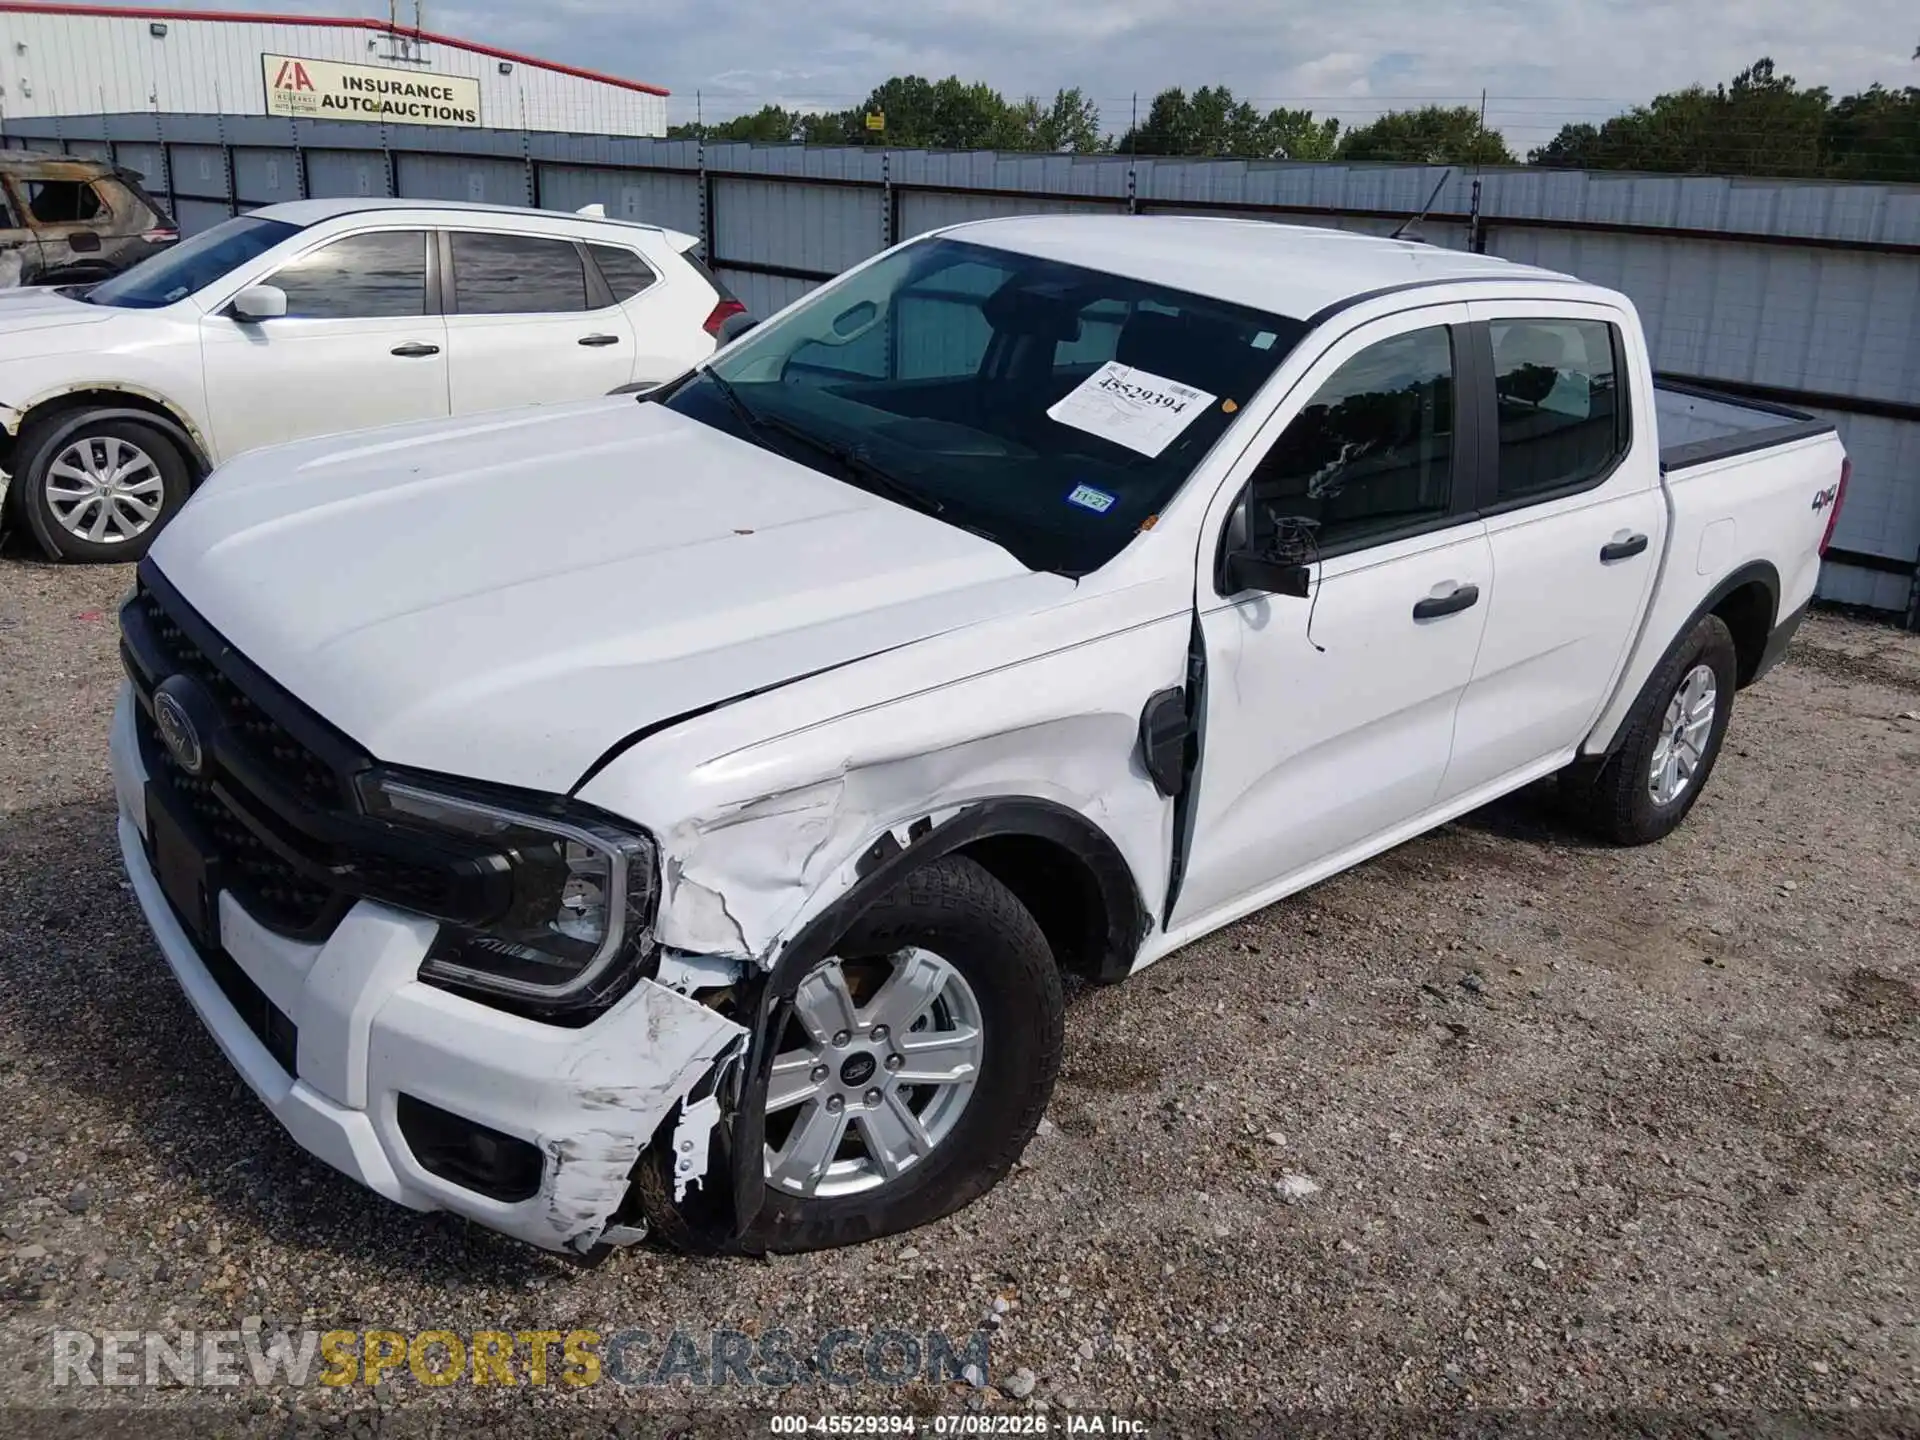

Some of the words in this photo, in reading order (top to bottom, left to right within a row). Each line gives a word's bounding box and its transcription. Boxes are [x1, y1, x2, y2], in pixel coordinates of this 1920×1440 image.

[343, 76, 453, 101] INSURANCE
[321, 95, 379, 112] AUTO
[380, 101, 476, 123] AUCTIONS
[1099, 378, 1187, 413] 45529394
